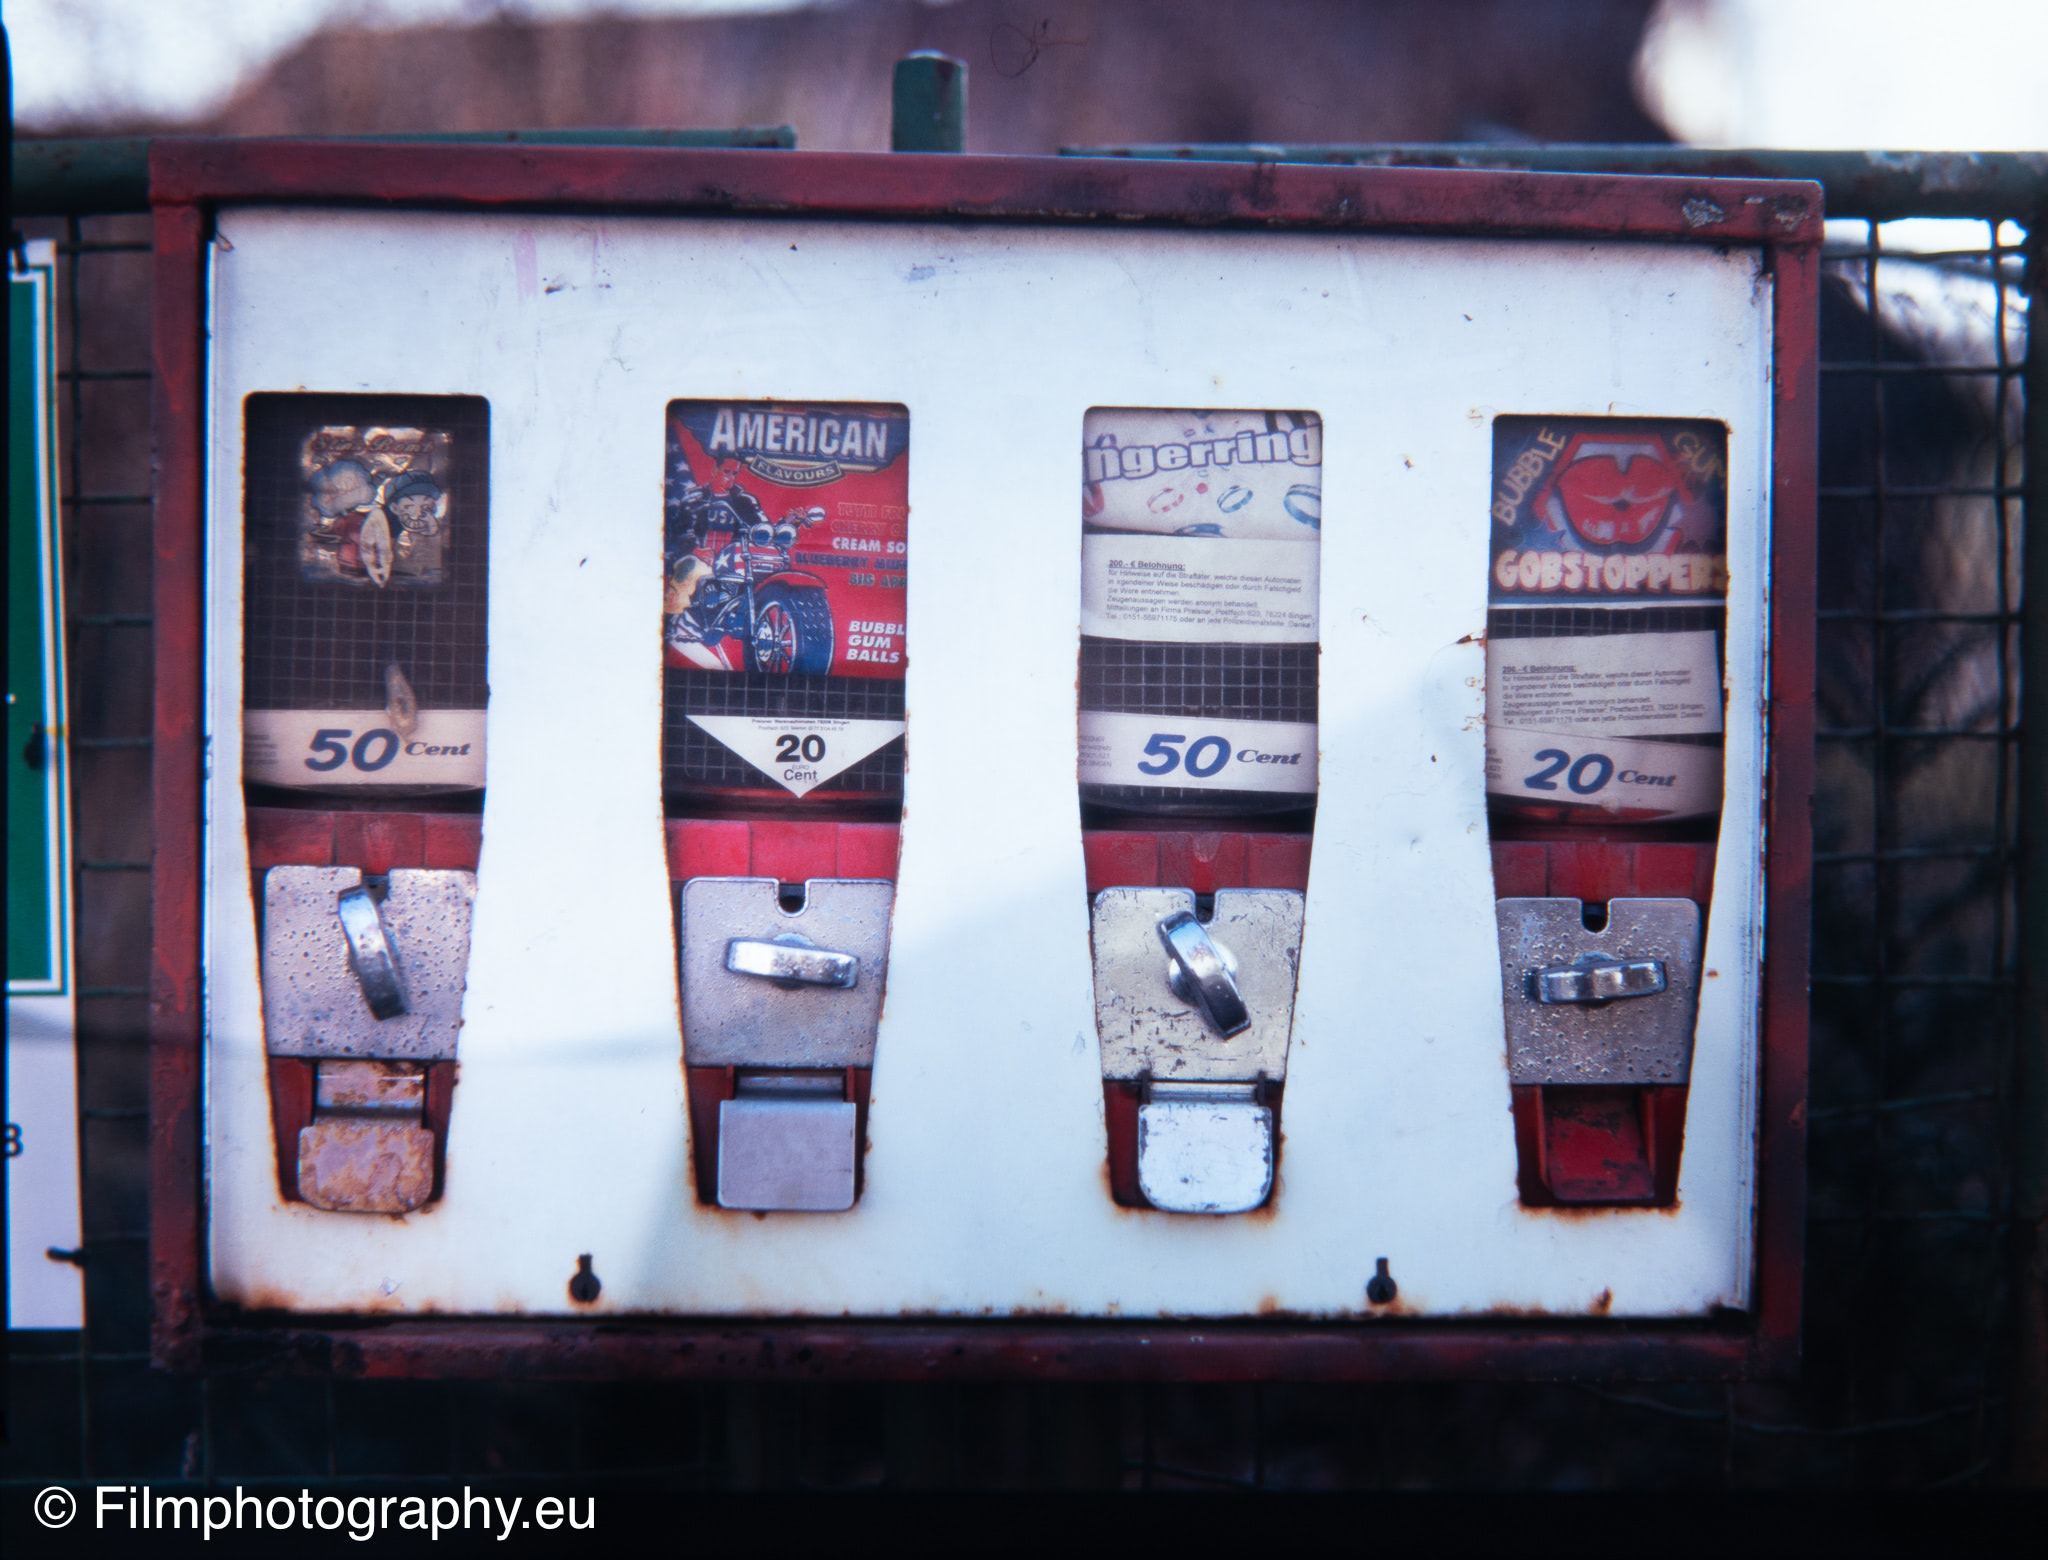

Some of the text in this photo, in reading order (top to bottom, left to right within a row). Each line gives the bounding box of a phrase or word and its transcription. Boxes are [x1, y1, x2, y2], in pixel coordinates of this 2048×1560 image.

[709, 408, 889, 459] AMERICAN
[757, 457, 836, 481] FLAVOURS
[1490, 426, 1567, 526] BUBBLE
[832, 536, 907, 554] CREAM SO
[848, 572, 876, 587] BIG
[848, 634, 892, 649] GUM
[846, 648, 901, 664] BALLS
[304, 728, 401, 772] 50
[404, 741, 472, 756] Cent
[775, 733, 826, 763] 20
[1137, 733, 1302, 778] 50 Cent
[783, 768, 819, 781] Cent
[1523, 748, 1615, 795] 20
[1617, 769, 1678, 787] Cent
